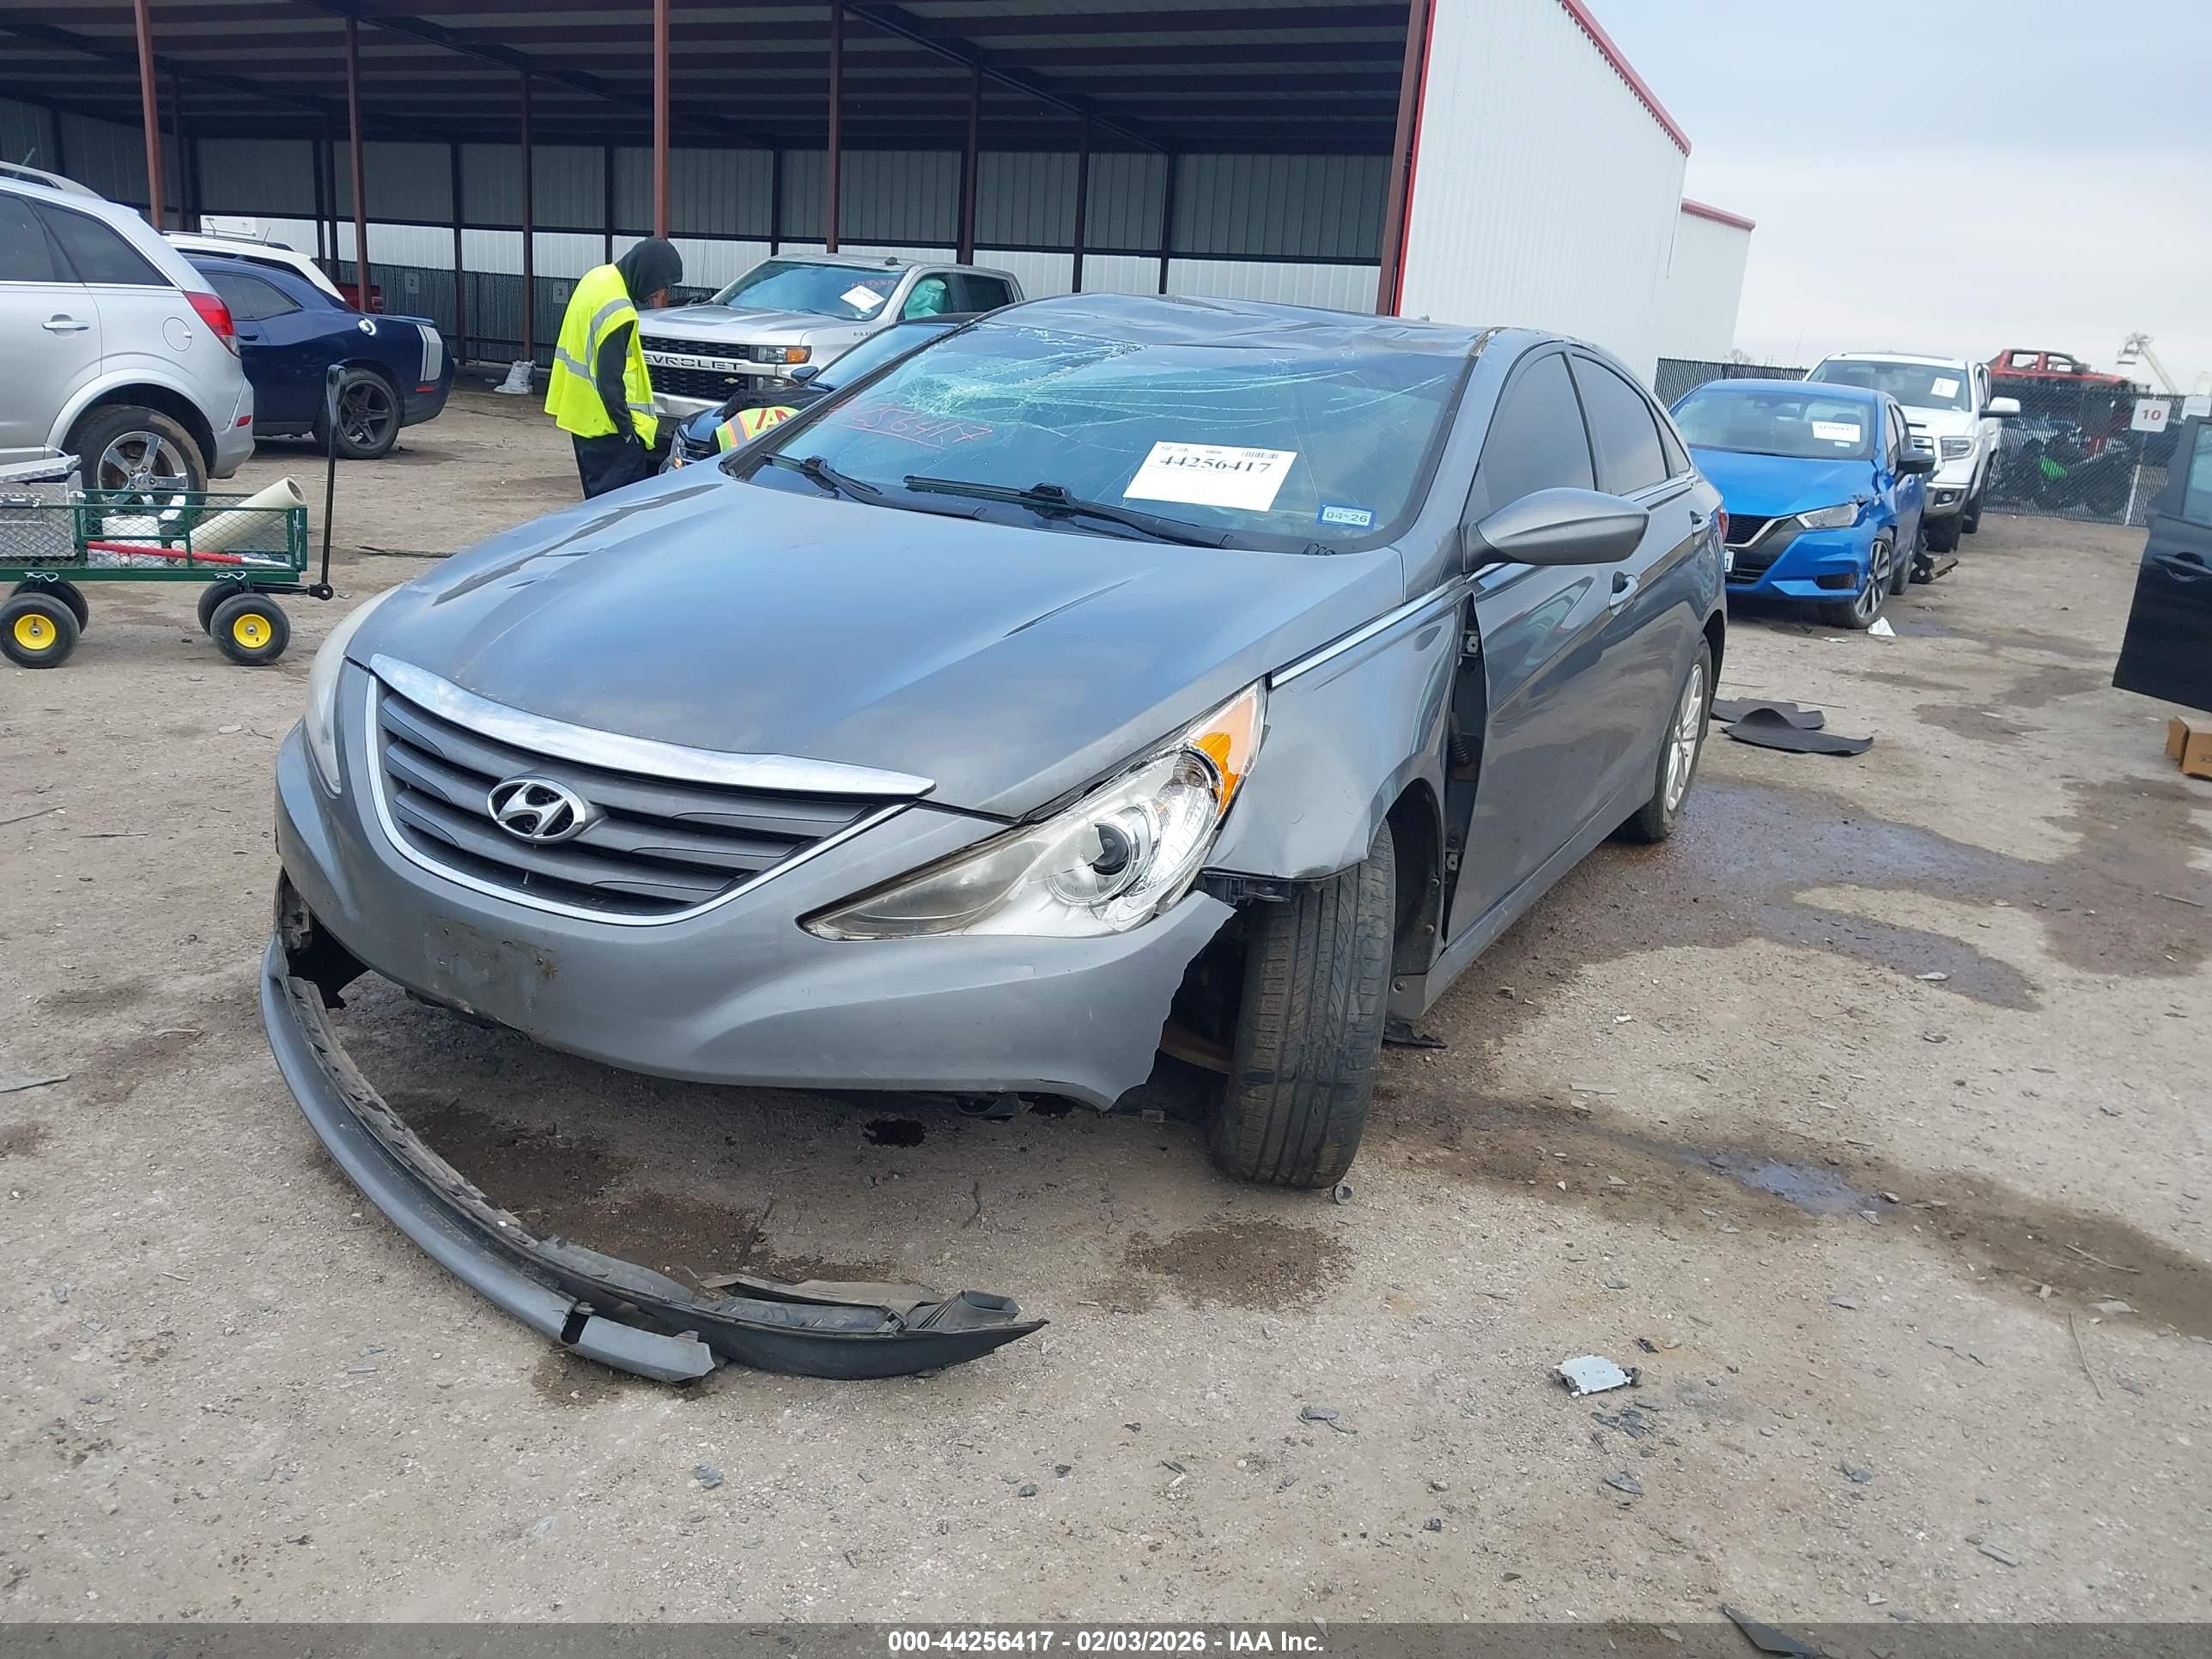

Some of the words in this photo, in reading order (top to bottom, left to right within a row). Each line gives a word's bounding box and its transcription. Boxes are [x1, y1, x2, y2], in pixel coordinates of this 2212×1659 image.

[644, 353, 743, 371] EVROLET
[2142, 409, 2161, 421] 10
[1160, 455, 1272, 473] 44256417
